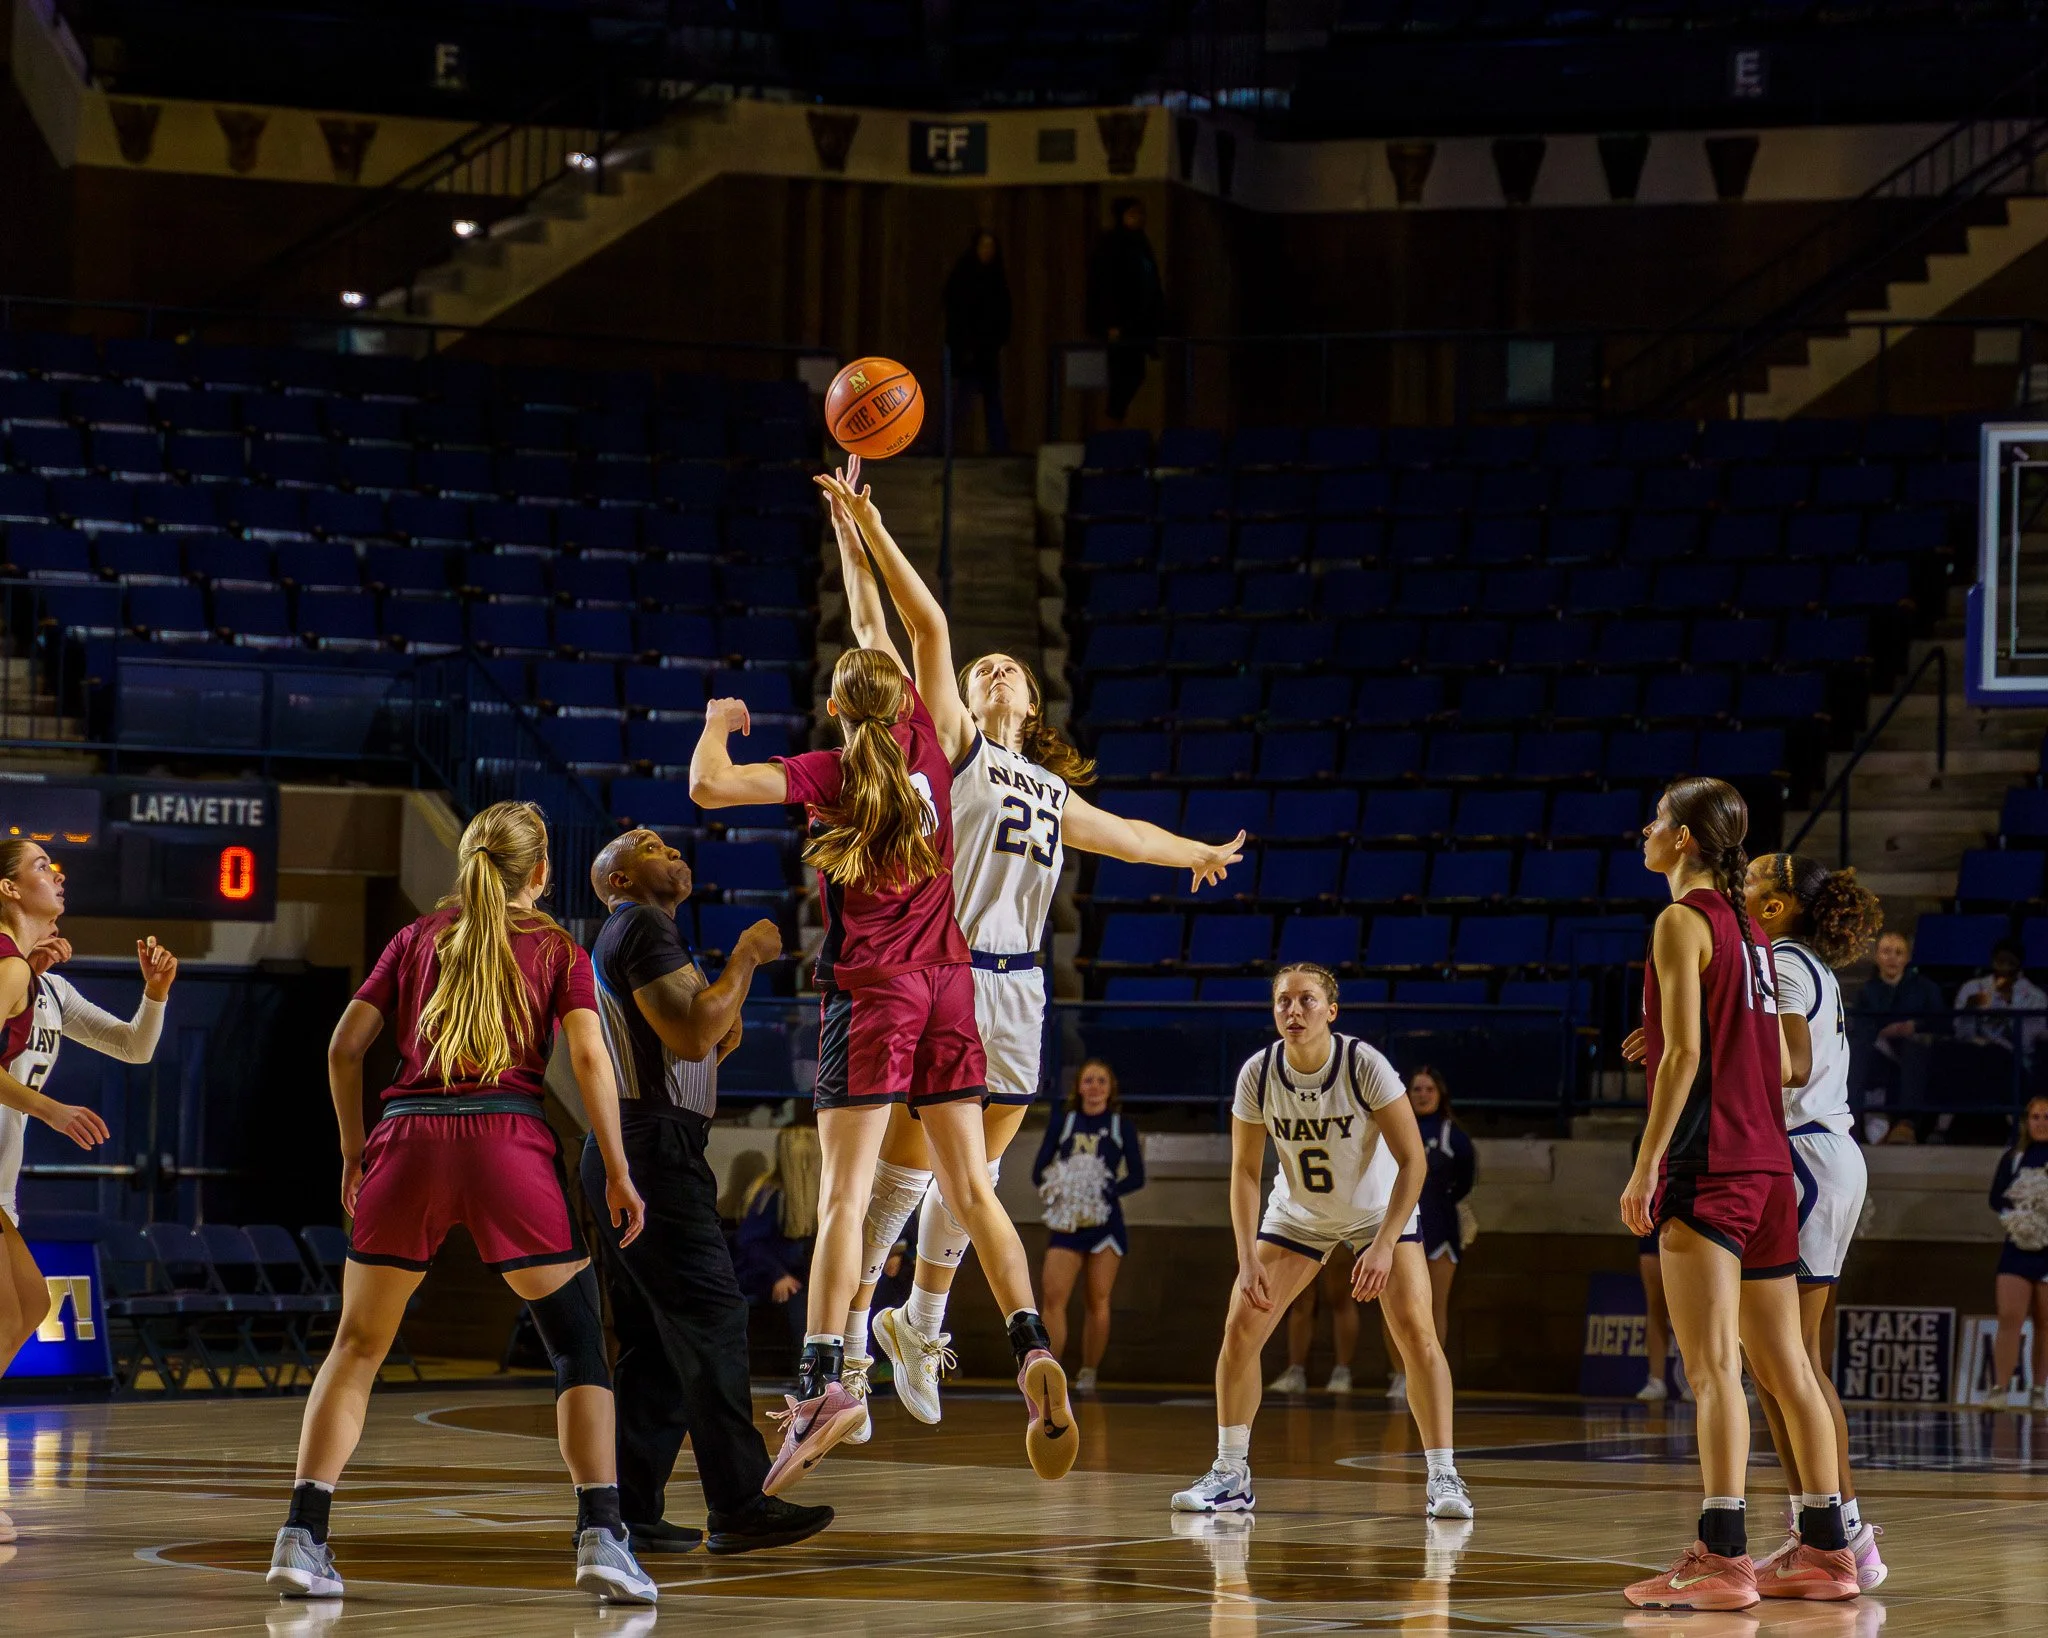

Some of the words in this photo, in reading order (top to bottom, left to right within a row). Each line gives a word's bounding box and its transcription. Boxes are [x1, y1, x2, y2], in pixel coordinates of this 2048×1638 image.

[927, 126, 970, 160] FF
[846, 406, 876, 435] THE
[872, 386, 907, 418] ROCK
[987, 766, 1061, 811] NAVY
[131, 793, 264, 827] LAFAYETTE
[993, 794, 1060, 870] 23
[220, 846, 253, 899] 0
[1272, 1114, 1355, 1142] NAVY
[1299, 1147, 1335, 1194] 6
[1846, 1310, 1940, 1342] MAKE
[1848, 1340, 1940, 1373] SOME
[1843, 1368, 1942, 1401] NOISE
